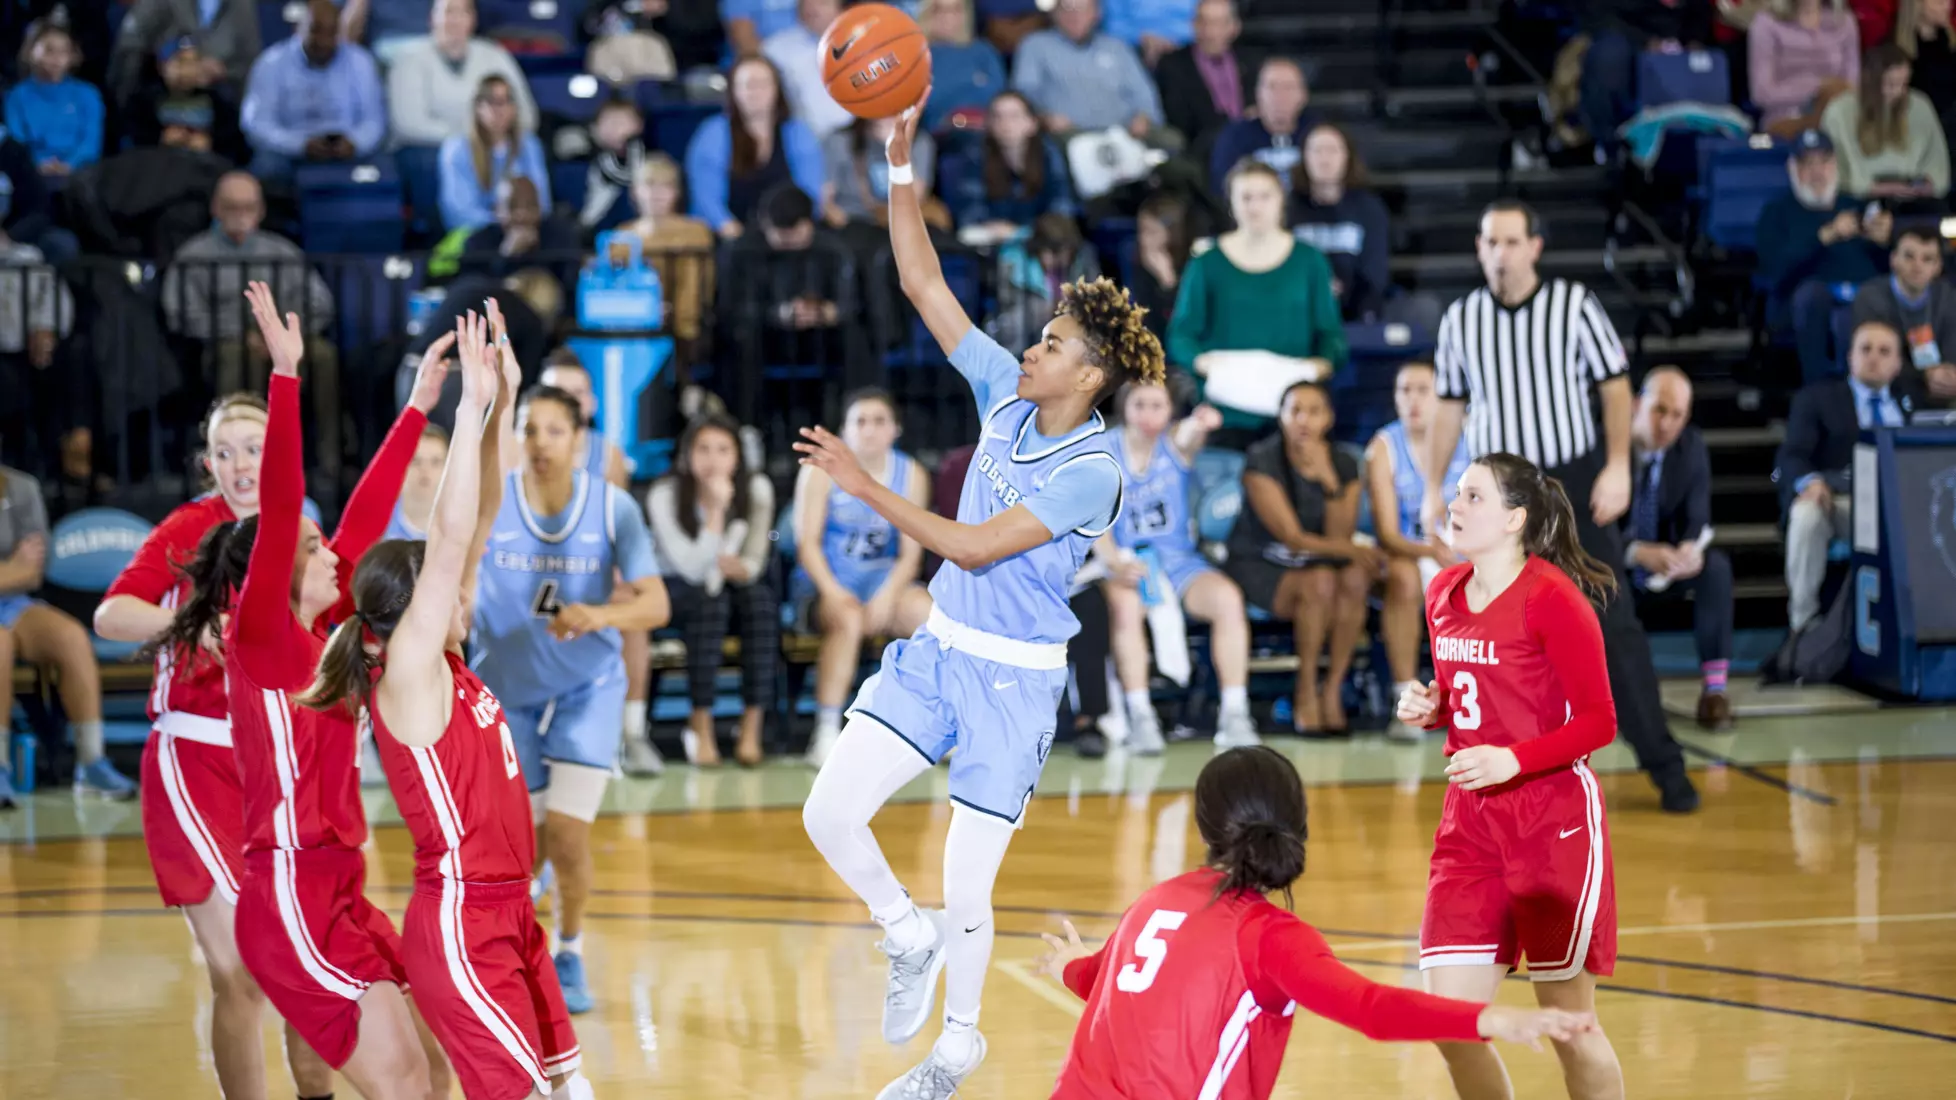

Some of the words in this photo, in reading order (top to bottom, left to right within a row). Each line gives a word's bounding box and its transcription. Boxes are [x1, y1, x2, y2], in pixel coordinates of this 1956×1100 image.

[1126, 498, 1173, 536] 13
[494, 550, 600, 575] COLUMBIA
[530, 578, 566, 623] 4
[1855, 565, 1881, 657] C
[1435, 636, 1500, 665] CORNELL
[1453, 670, 1482, 731] 3
[1116, 908, 1189, 994] 5
